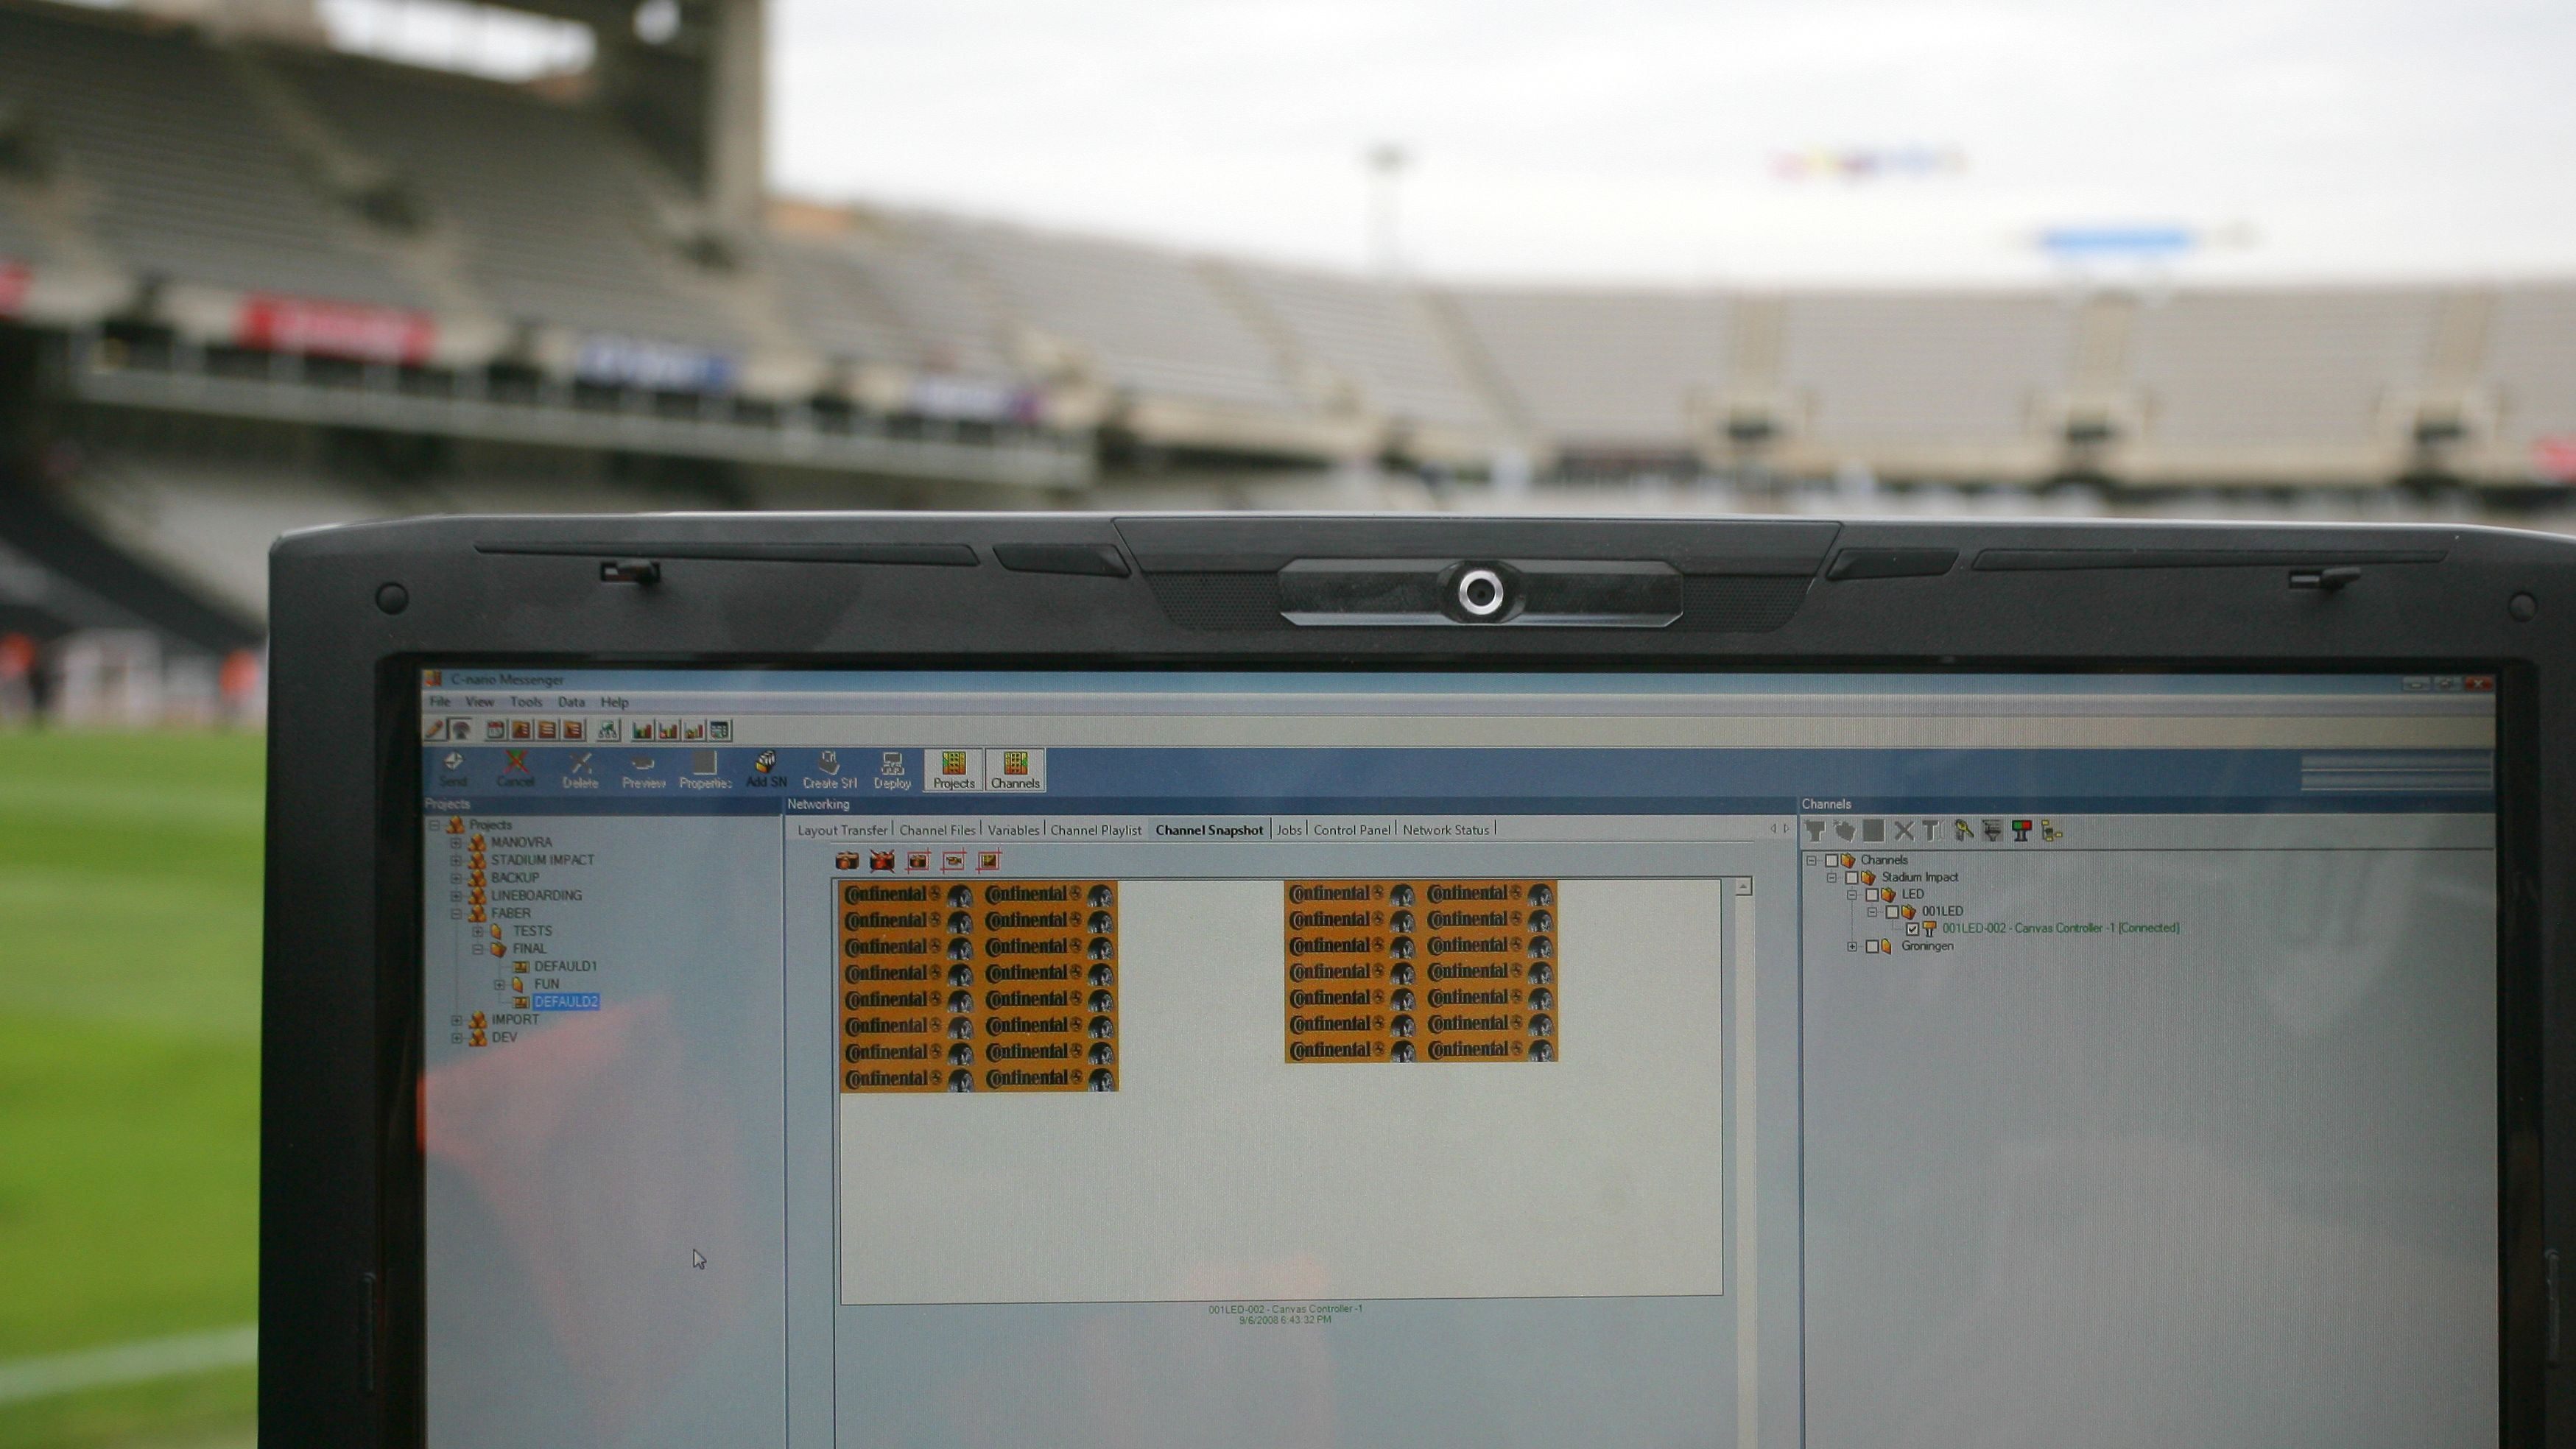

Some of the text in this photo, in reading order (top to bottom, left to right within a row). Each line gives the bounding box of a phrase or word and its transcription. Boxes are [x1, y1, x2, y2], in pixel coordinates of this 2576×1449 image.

[500, 674, 564, 688] Messenger
[430, 697, 451, 708] File
[465, 697, 495, 708] View
[510, 696, 543, 708] Tools
[559, 696, 585, 708] Data
[601, 696, 630, 711] Help
[497, 776, 535, 787] Cancel
[563, 776, 599, 789] Delete
[622, 777, 666, 789] Preview
[747, 776, 787, 787] Add SN
[803, 777, 838, 789] Create
[874, 777, 912, 791] Deploy
[934, 778, 975, 790] Projects
[991, 778, 1040, 789] Channels
[425, 797, 470, 810] Projects
[788, 798, 850, 812] Networking
[1802, 797, 1851, 809] Channels
[470, 819, 512, 832] Projects
[798, 824, 888, 837] Layout Transfer
[899, 824, 976, 836] Channel Files
[988, 824, 1039, 836] Variables
[1051, 824, 1142, 837] Channel Playlist
[1155, 824, 1264, 838] Channel Snapshot
[1277, 824, 1302, 836] Jobs
[1313, 824, 1392, 836] Control Panel
[1404, 824, 1490, 836] Network Status
[491, 837, 552, 848] MANOVRA
[491, 854, 595, 865] STADIUM IMPACT
[1861, 854, 1908, 866] Channels
[491, 872, 540, 884] BACKUP
[1882, 871, 1959, 885] Stadium Impact
[491, 889, 583, 901] LINEBOARDING
[845, 885, 927, 905] Continental
[985, 885, 1067, 905] Continental
[1289, 884, 1370, 903] Continental
[1427, 884, 1507, 903] Continental
[1902, 889, 1924, 900] LED
[491, 908, 531, 919] FABER
[1922, 906, 1963, 917] 001LED
[845, 912, 927, 931] Continental
[985, 911, 1067, 931] Continental
[1289, 910, 1370, 929] Continental
[1427, 910, 1507, 929] Continental
[514, 926, 552, 937] TESTS
[1943, 923, 2006, 934] 001LED-002
[2016, 923, 2053, 934] Canvas
[2056, 923, 2103, 934] Controller
[2119, 922, 2181, 935] [Connected]
[514, 943, 547, 954] FINAL
[845, 938, 927, 957] Continental
[985, 937, 1067, 957] Continental
[1289, 937, 1370, 956] Continental
[1427, 936, 1507, 955] Continental
[1902, 940, 1954, 953] Groningen
[535, 961, 597, 972] DEFAULD1
[1289, 962, 1370, 981] Continental
[1427, 962, 1507, 981] Continental
[845, 964, 927, 984] Continental
[985, 963, 1067, 984] Continental
[535, 979, 560, 990] FUN
[535, 996, 599, 1008] DEFAULD2
[845, 990, 927, 1010] Continental
[985, 990, 1067, 1009] Continental
[1289, 988, 1370, 1008] Continental
[1427, 987, 1507, 1007] Continental
[492, 1014, 540, 1026] IMPORT
[845, 1017, 927, 1036] Continental
[985, 1015, 1067, 1036] Continental
[1289, 1015, 1370, 1034] Continental
[1427, 1014, 1507, 1034] Continental
[492, 1032, 518, 1043] DEV
[845, 1043, 927, 1062] Continental
[985, 1042, 1067, 1062] Continental
[1289, 1040, 1370, 1060] Continental
[1427, 1040, 1507, 1060] Continental
[845, 1070, 927, 1089] Continental
[985, 1068, 1067, 1089] Continental
[1208, 1305, 1264, 1314] 001LED-002
[1272, 1305, 1306, 1314] Canvas
[1309, 1305, 1353, 1314] Controller
[1239, 1316, 1331, 1325] 9/6/2008 6:43:32 PM
